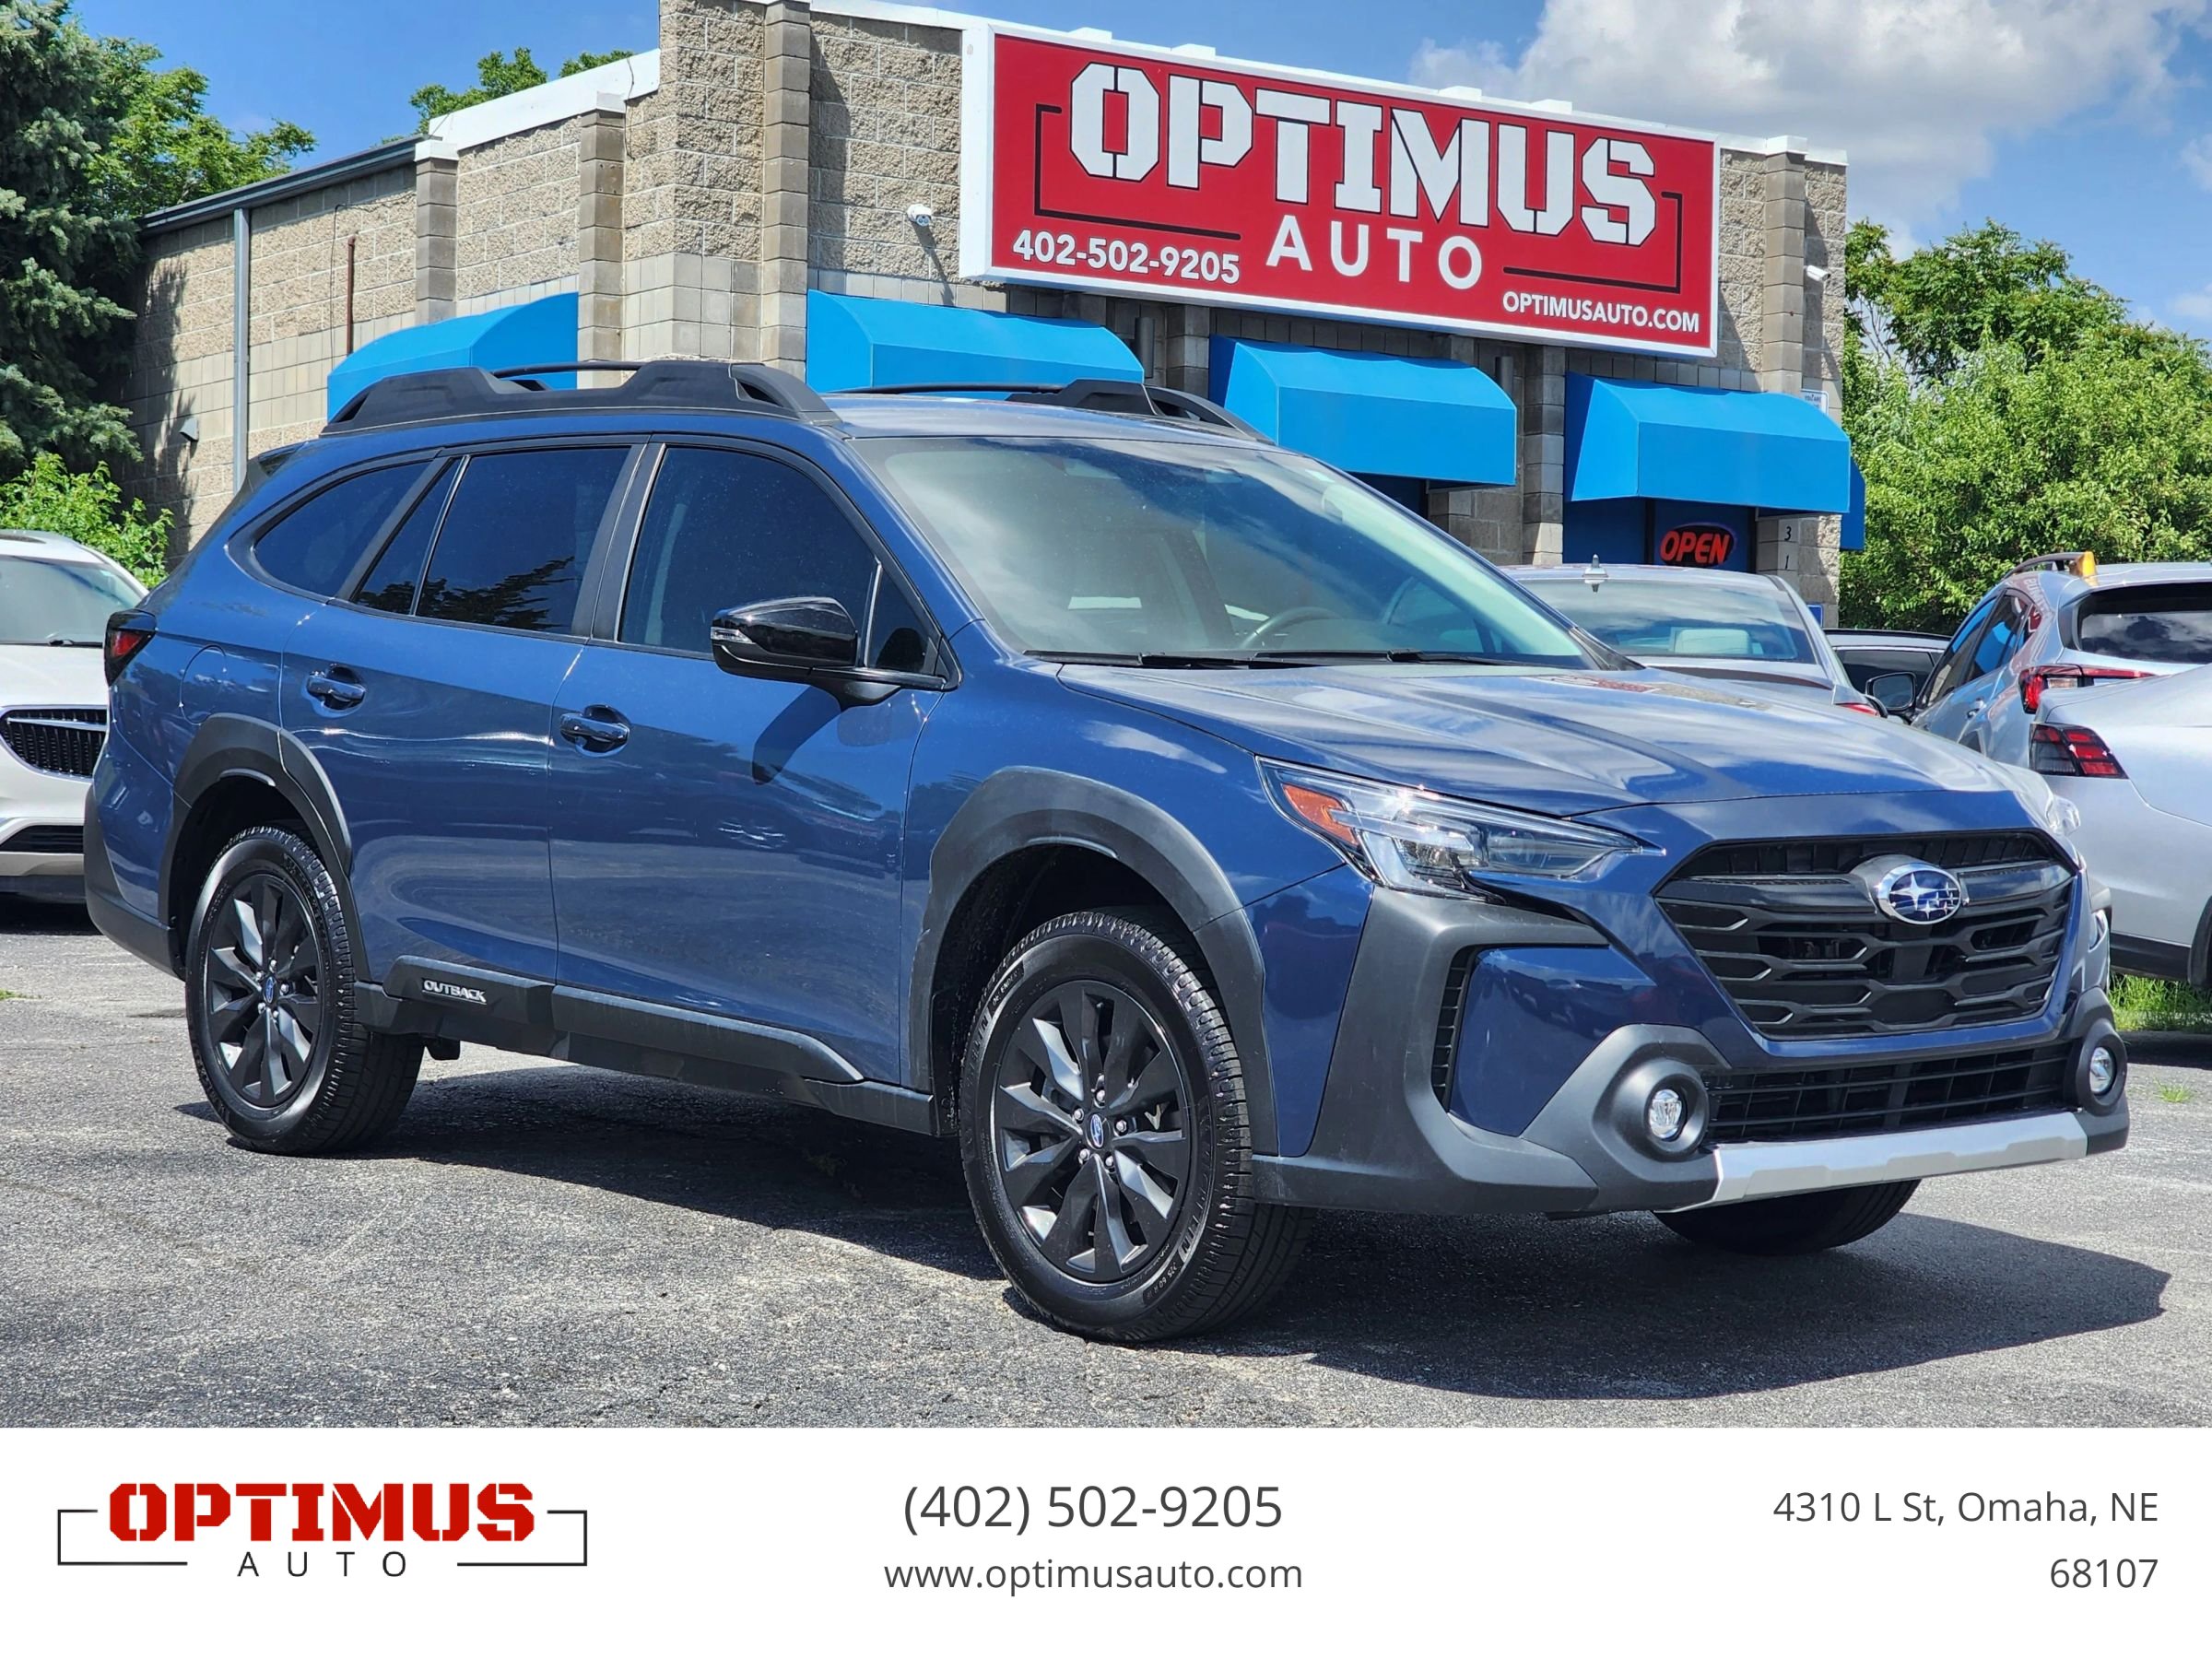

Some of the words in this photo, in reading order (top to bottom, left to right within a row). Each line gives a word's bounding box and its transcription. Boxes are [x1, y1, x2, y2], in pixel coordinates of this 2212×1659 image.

[1070, 62, 1657, 247] OPTIMUS
[1012, 229, 1241, 285] 402-502-9205
[1265, 215, 1483, 290] AUTO
[1502, 290, 1700, 334] OPTIMUSAUTO.COM
[1660, 529, 1731, 565] OPEN
[423, 979, 488, 1003] OUTBACK
